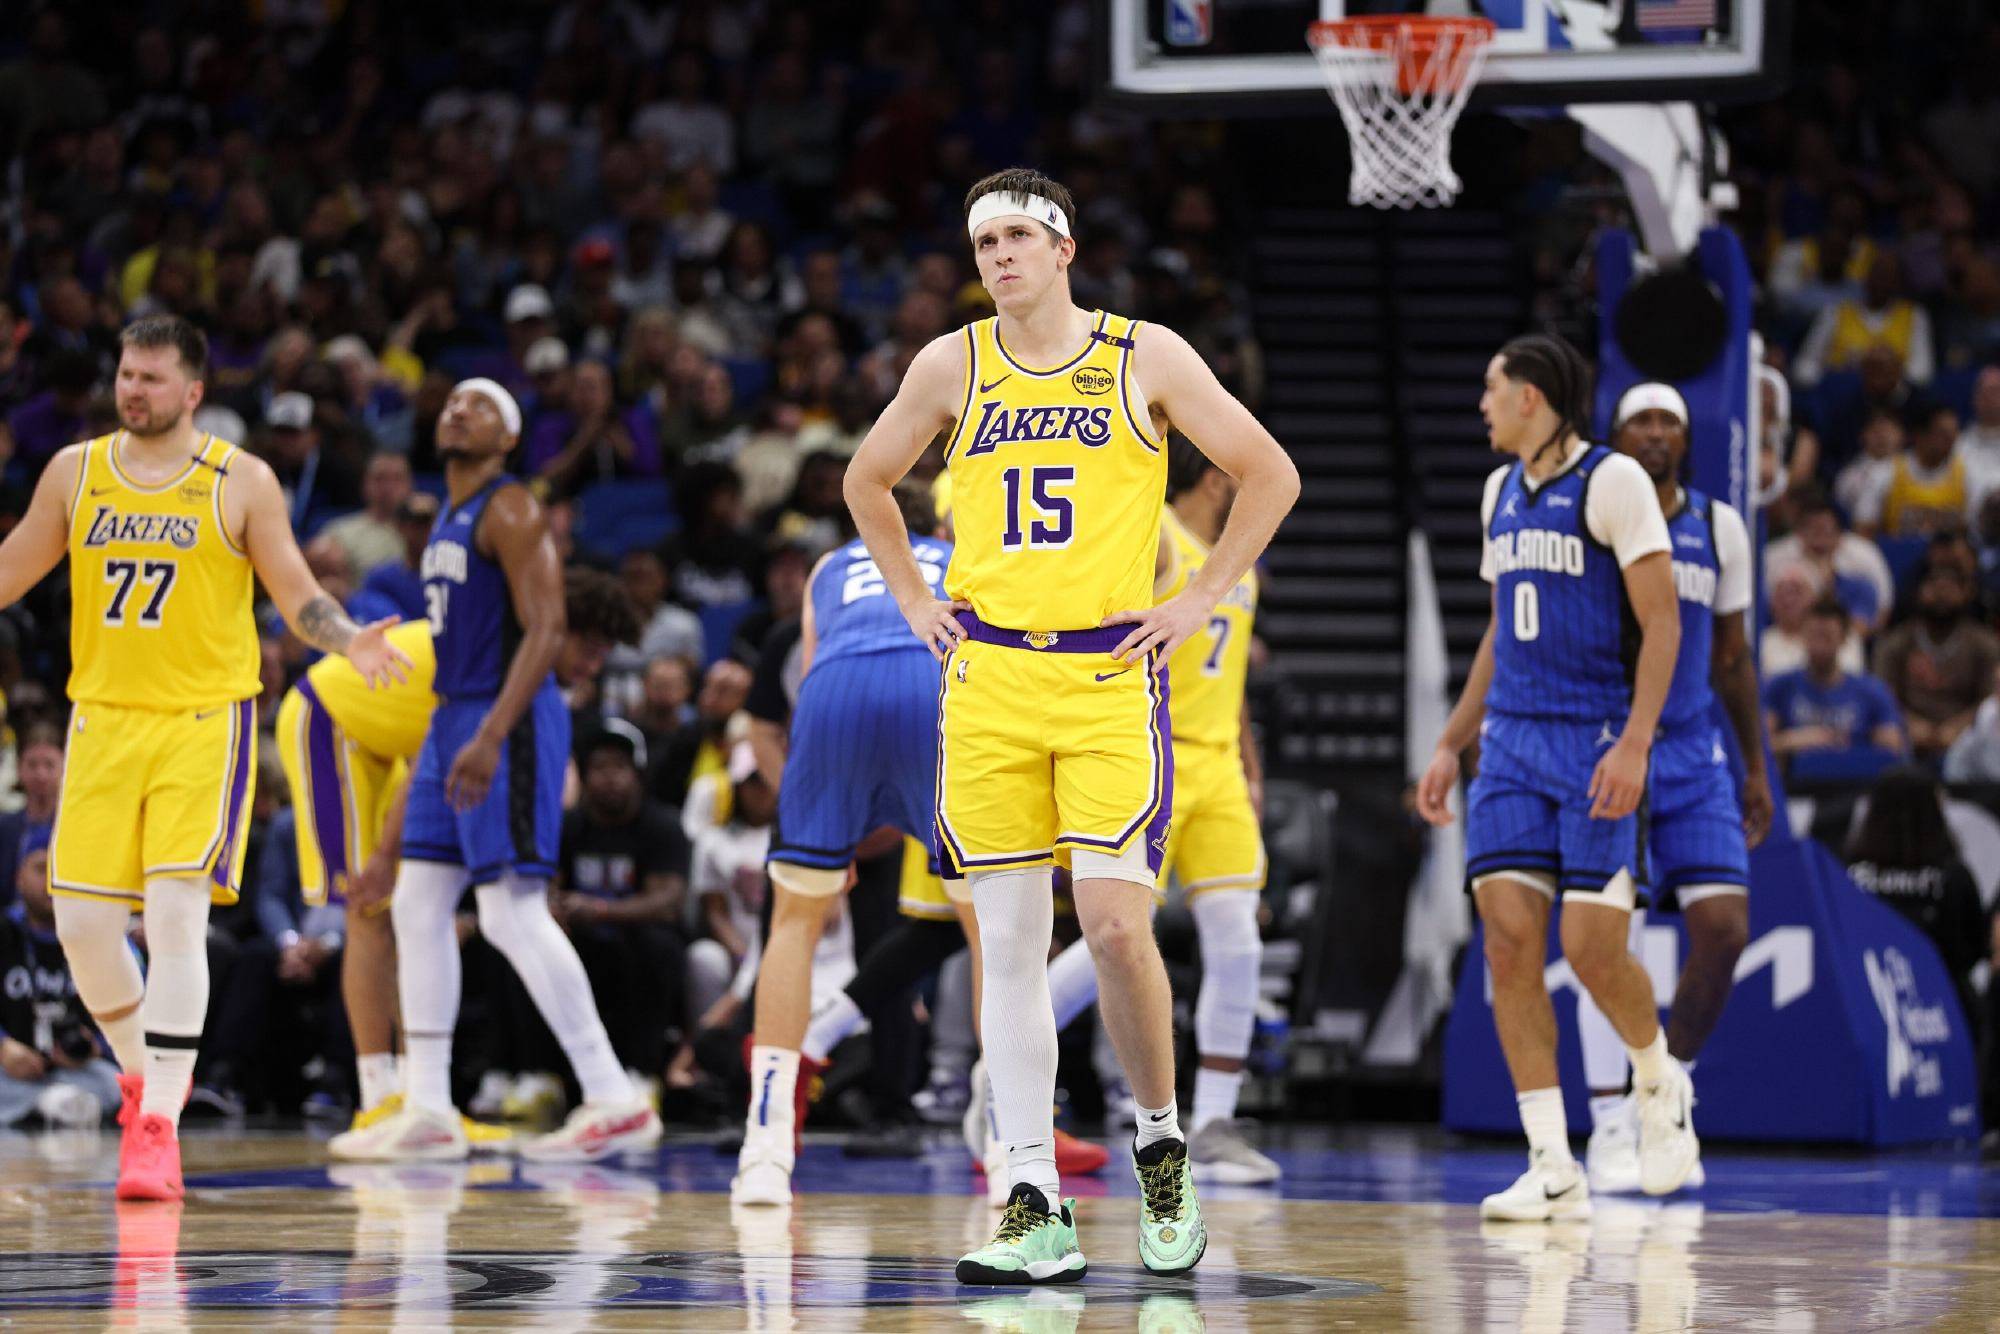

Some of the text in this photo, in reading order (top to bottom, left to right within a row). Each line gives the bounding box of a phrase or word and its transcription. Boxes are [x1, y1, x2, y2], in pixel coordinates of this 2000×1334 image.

[1076, 374, 1112, 388] bibigo
[965, 400, 1114, 458] LAKERS
[84, 506, 200, 549] LAKERS
[1001, 465, 1077, 554] 15
[102, 557, 179, 630] 77
[1514, 580, 1540, 642] 0
[1201, 615, 1230, 677] 7
